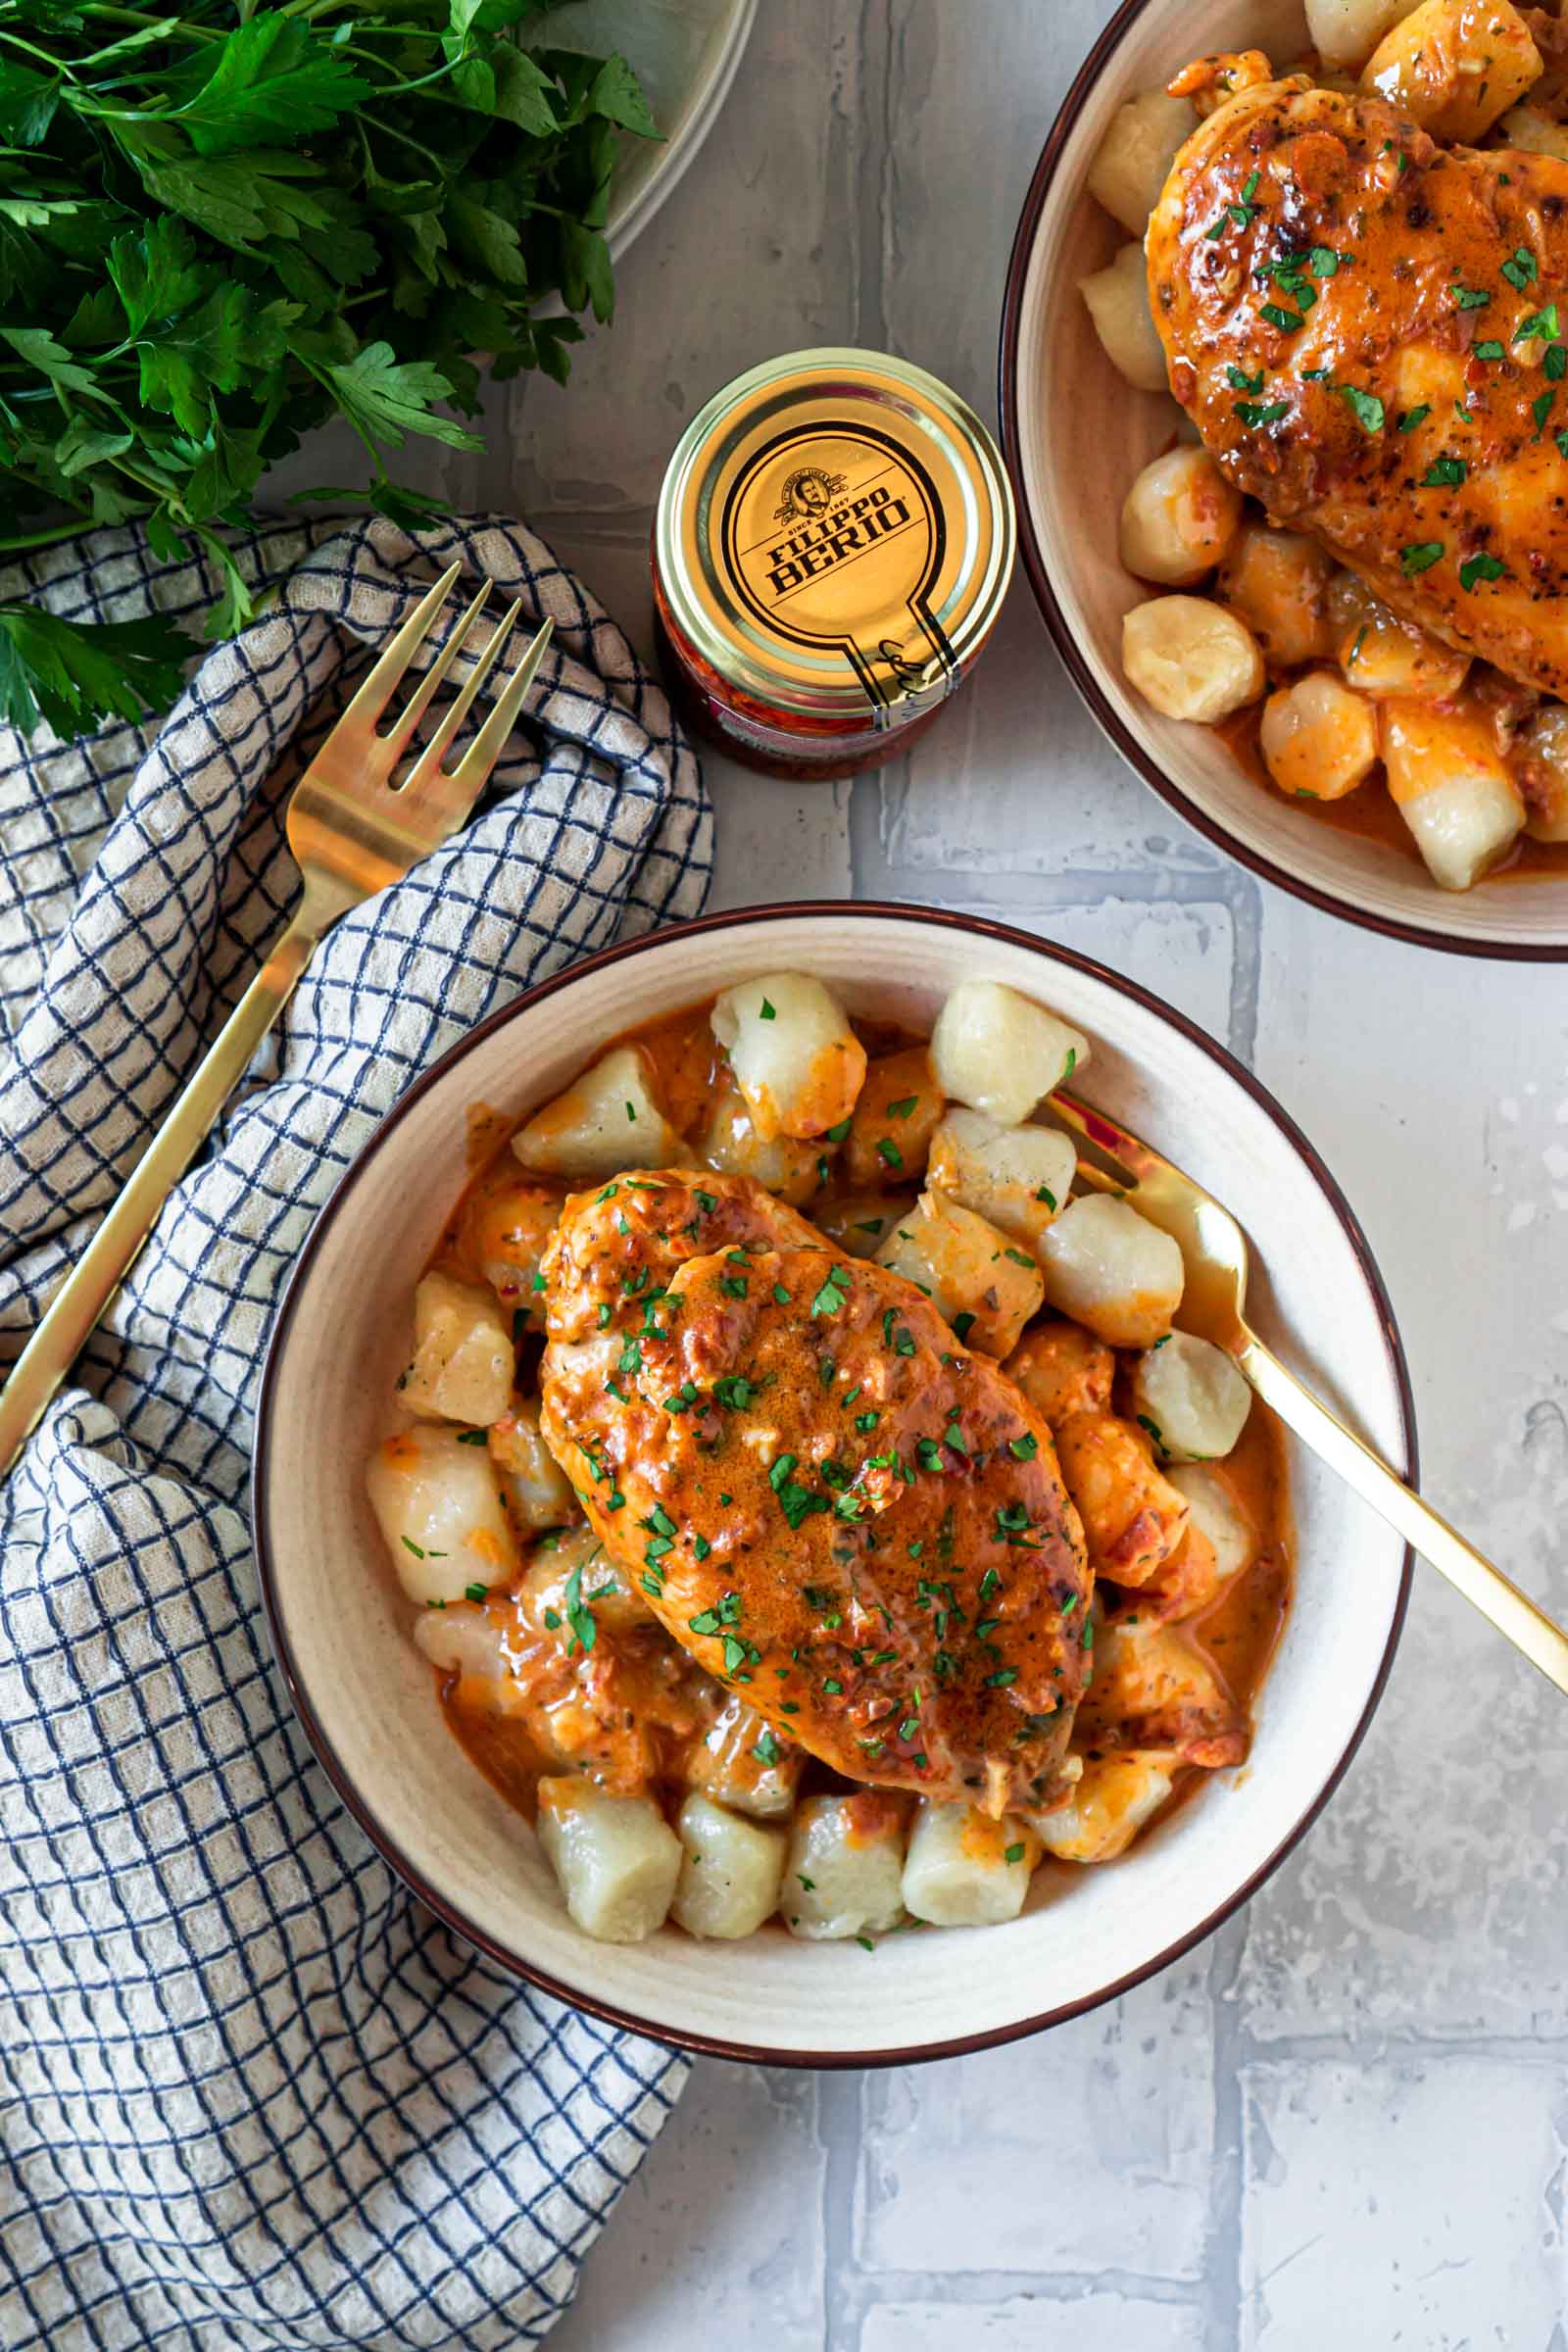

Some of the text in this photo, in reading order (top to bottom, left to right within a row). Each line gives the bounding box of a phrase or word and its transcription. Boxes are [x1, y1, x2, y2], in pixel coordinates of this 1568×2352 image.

[764, 500, 911, 596] BERIO
[765, 486, 891, 566] FILIPPO
[788, 519, 812, 536] SINCE
